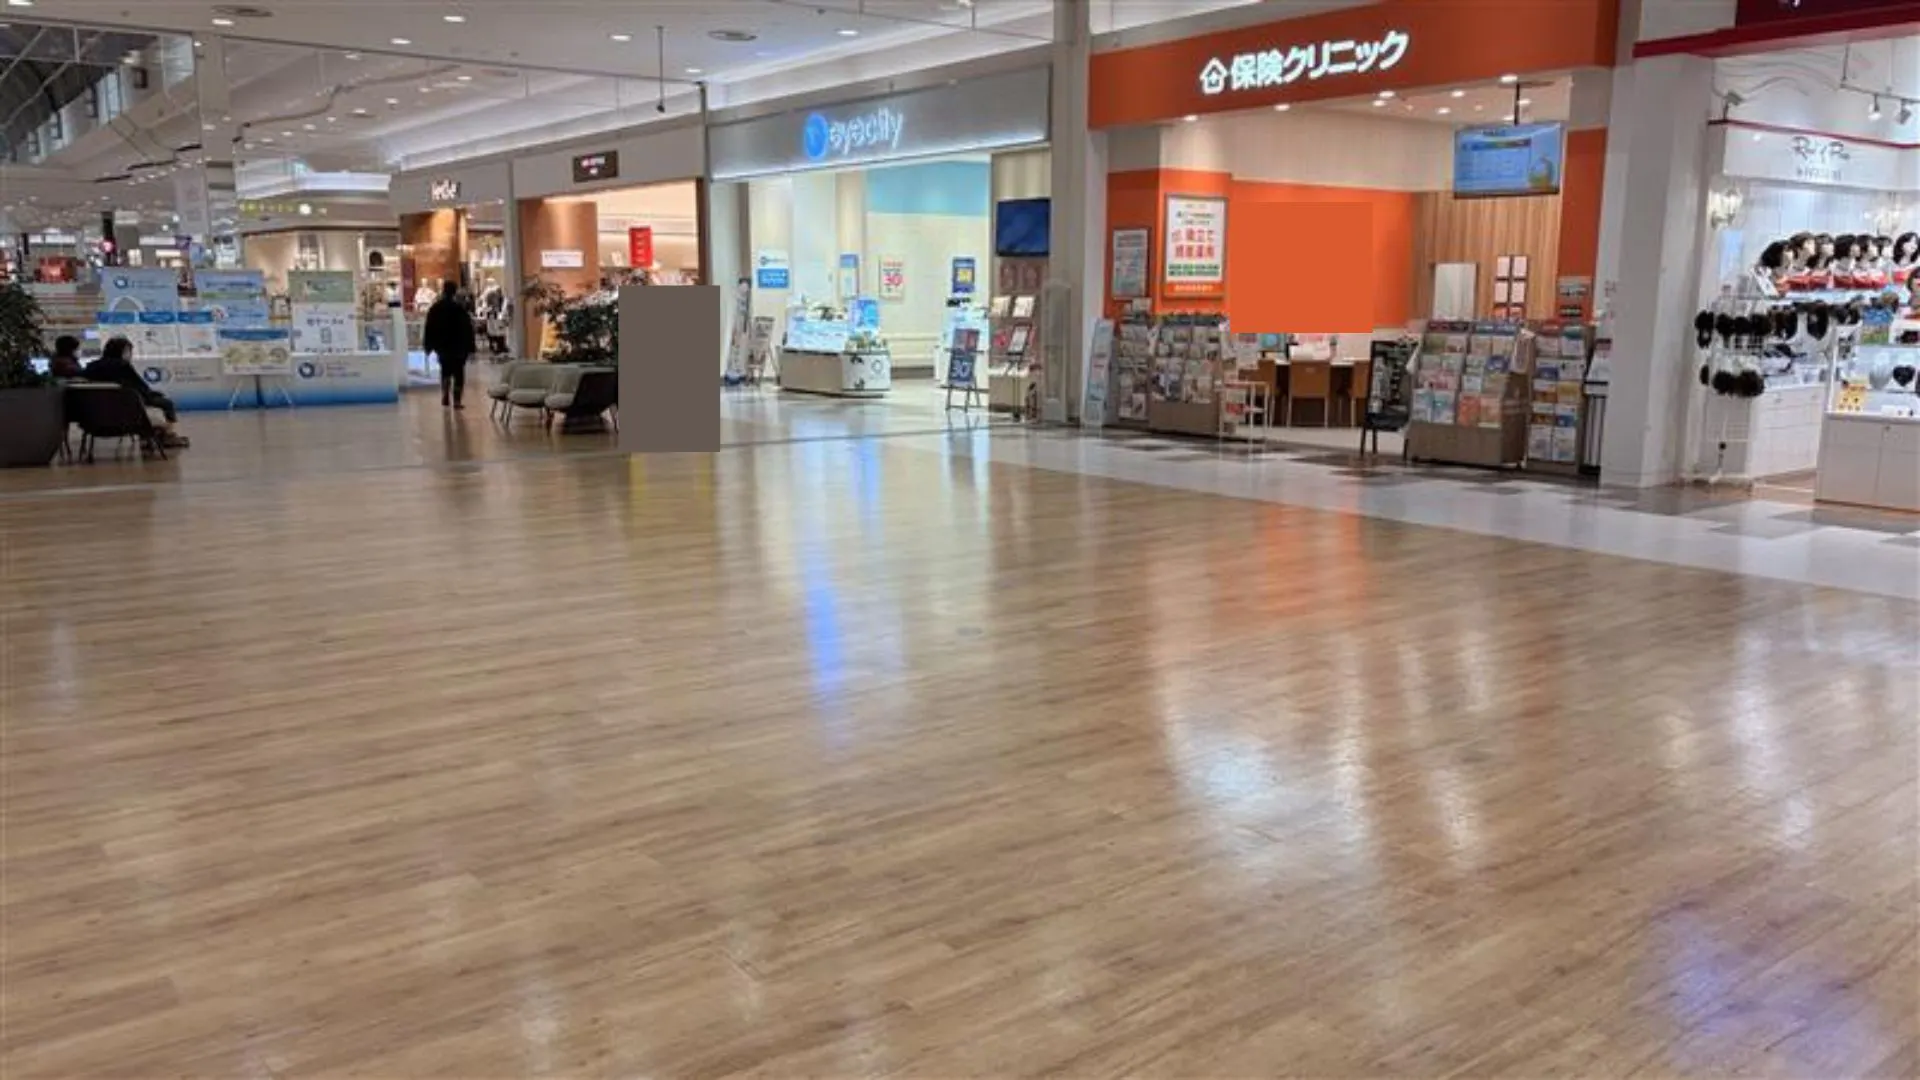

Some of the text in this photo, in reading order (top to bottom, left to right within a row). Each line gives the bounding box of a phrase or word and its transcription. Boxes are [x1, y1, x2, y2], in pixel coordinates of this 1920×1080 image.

[1231, 31, 1408, 90] 保険クリニック
